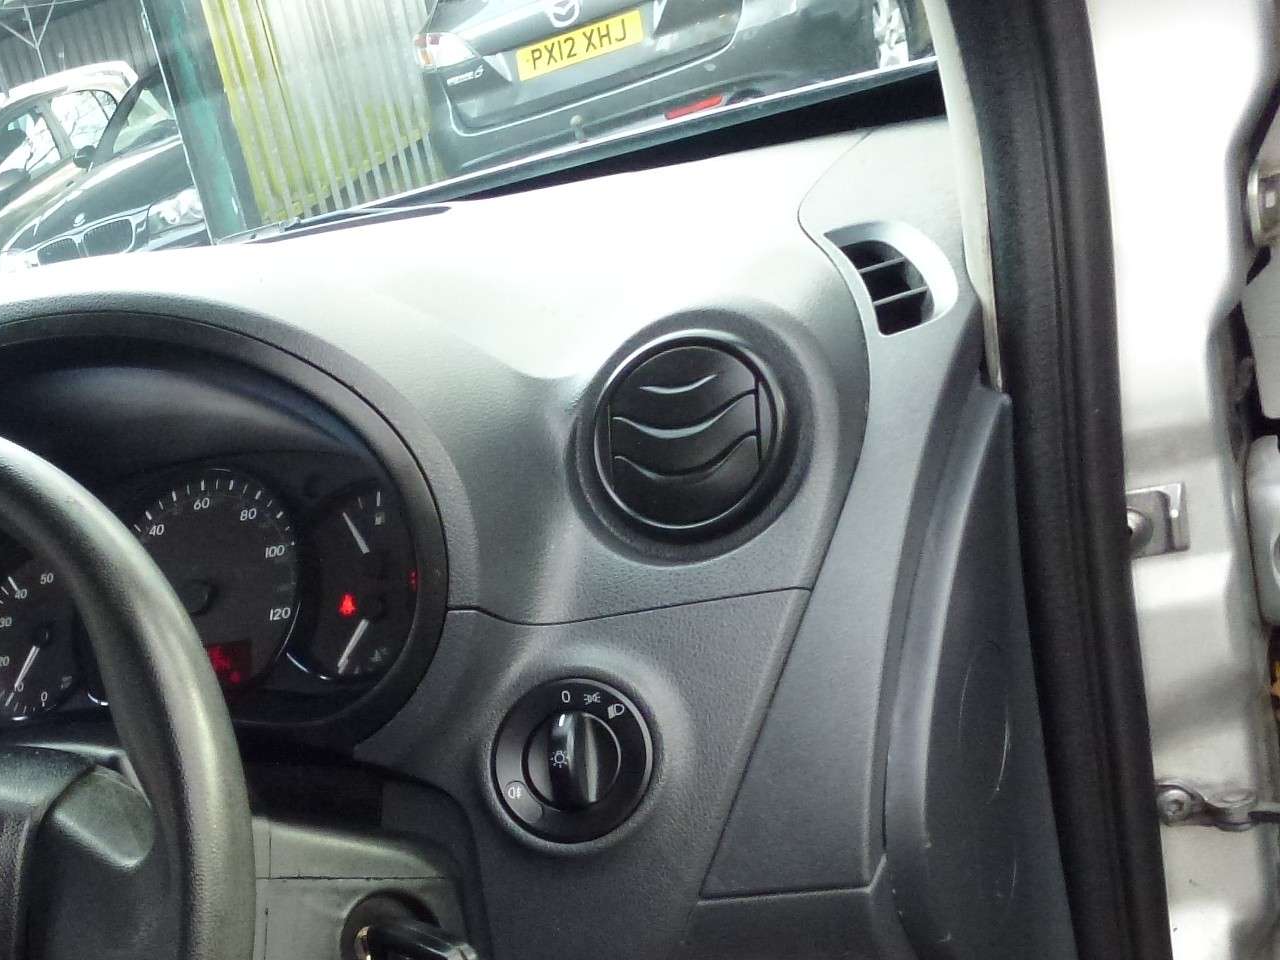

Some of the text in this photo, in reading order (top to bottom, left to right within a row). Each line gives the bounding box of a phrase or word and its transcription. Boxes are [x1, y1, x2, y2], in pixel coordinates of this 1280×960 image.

[531, 19, 628, 71] PX12 XHJ
[193, 497, 210, 511] 60
[240, 508, 257, 521] 80
[149, 524, 165, 536] 40
[265, 545, 285, 559] 100
[40, 572, 54, 585] 50
[14, 588, 28, 600] 40
[269, 607, 291, 621] 120
[40, 691, 48, 702] 0
[561, 690, 571, 703] 0
